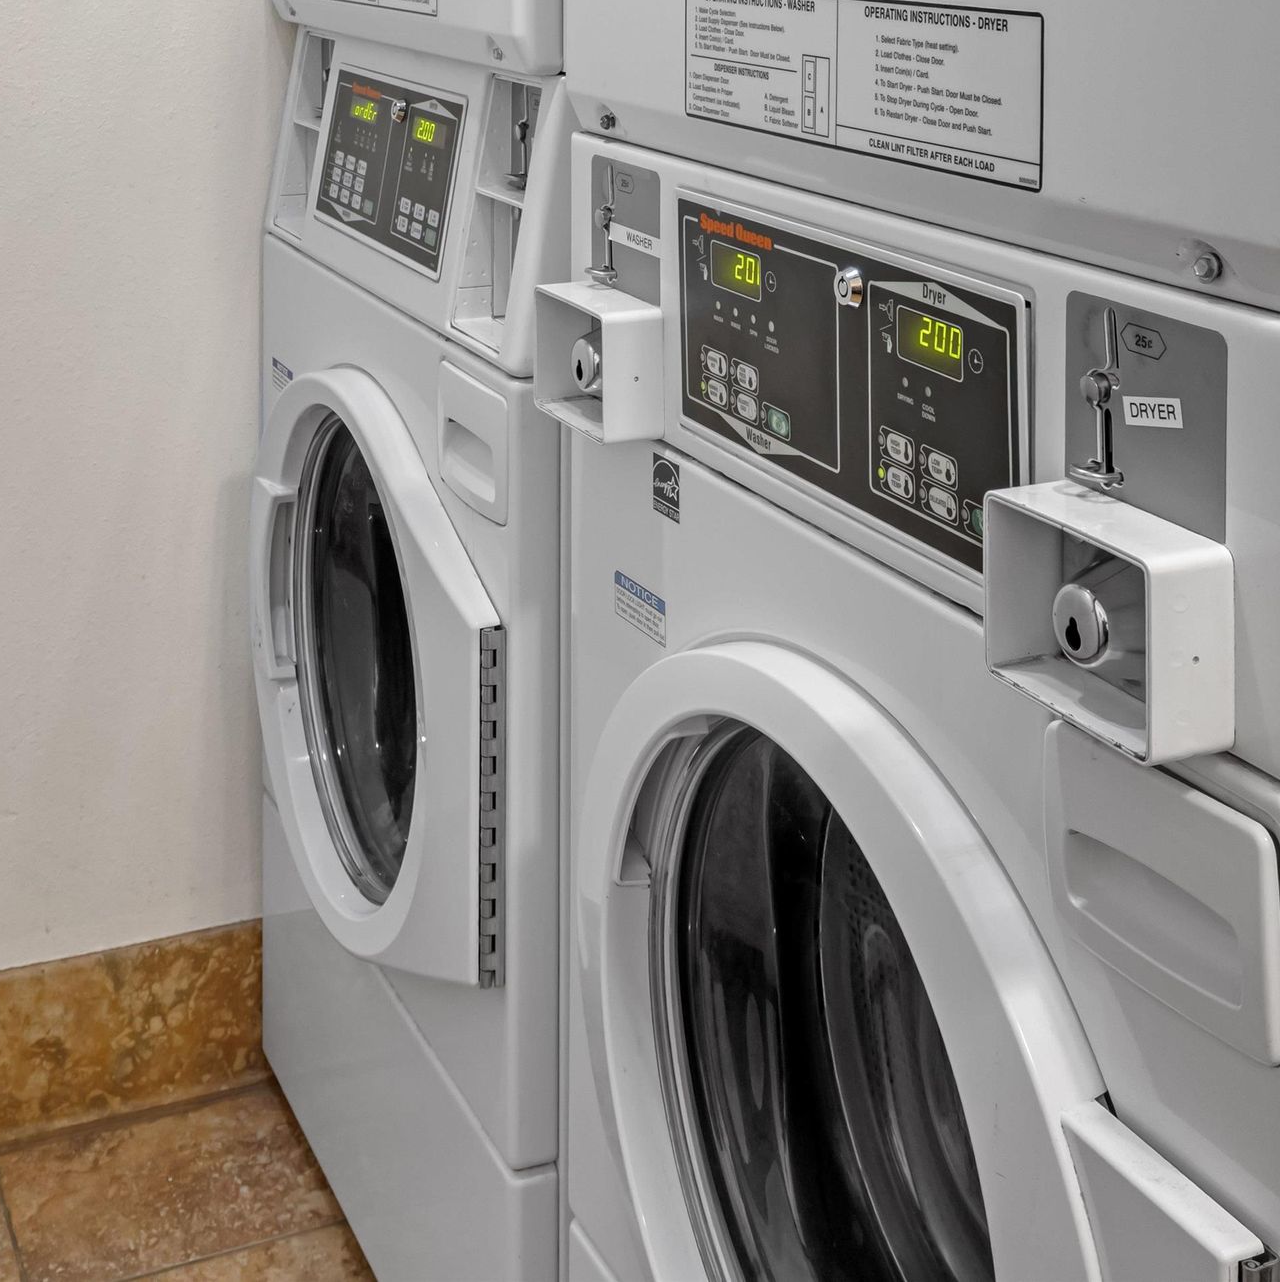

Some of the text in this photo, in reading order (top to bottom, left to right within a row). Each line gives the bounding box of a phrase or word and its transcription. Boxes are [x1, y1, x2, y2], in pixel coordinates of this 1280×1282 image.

[864, 6, 908, 22] OPERATING
[910, 10, 970, 28] INSTRUCTIONS
[978, 16, 1008, 32] DRYER
[875, 35, 880, 43] 1.
[880, 35, 895, 45] Select
[897, 37, 911, 46] Fabric
[912, 39, 924, 49] Type
[925, 40, 938, 50] (heat
[875, 49, 880, 57] 2.
[880, 50, 893, 59] Load
[894, 51, 912, 61] Clothes
[916, 54, 930, 64] Close
[931, 56, 945, 66] Door.
[714, 63, 769, 80] DISPENSER INSTRUCTIONS
[880, 64, 894, 73] Insert
[895, 66, 912, 77] Coin(s)
[916, 70, 930, 79] Card.
[875, 78, 880, 87] 4.
[880, 79, 886, 87] To
[886, 80, 898, 89] Start
[899, 82, 912, 92] Dryer
[917, 85, 930, 94] Push
[946, 89, 958, 99] Door
[959, 92, 973, 101] Must
[974, 93, 980, 102] be
[982, 94, 1002, 105] Closed.
[880, 93, 885, 102] To
[886, 94, 897, 105] Stop
[898, 97, 912, 108] Dryer
[913, 99, 930, 110] During
[930, 102, 944, 113] Cycle
[949, 105, 963, 116] Open
[964, 108, 979, 118] Door.
[769, 116, 781, 125] Fabric
[782, 118, 798, 129] Softener
[880, 108, 885, 117] To
[886, 109, 904, 120] Restart
[905, 113, 918, 124] Dryer
[922, 116, 937, 126] Close
[938, 119, 951, 128] Door
[951, 120, 961, 130] and
[962, 123, 976, 133] Push
[978, 126, 992, 136] Start.
[869, 138, 995, 172] CLEAN LINT FILTER AFTER EACH LOAD
[626, 231, 652, 250] WASHER
[700, 212, 773, 251] Speed Queen
[922, 283, 946, 305] Dryer
[1135, 333, 1153, 349] 25¢
[922, 403, 935, 415] COOL
[922, 411, 936, 422] DOWN
[1130, 402, 1177, 421] DRYER
[745, 426, 771, 451] Washer
[931, 458, 940, 466] LOW
[932, 465, 942, 474] TEMP
[621, 576, 658, 608] NOTICE
